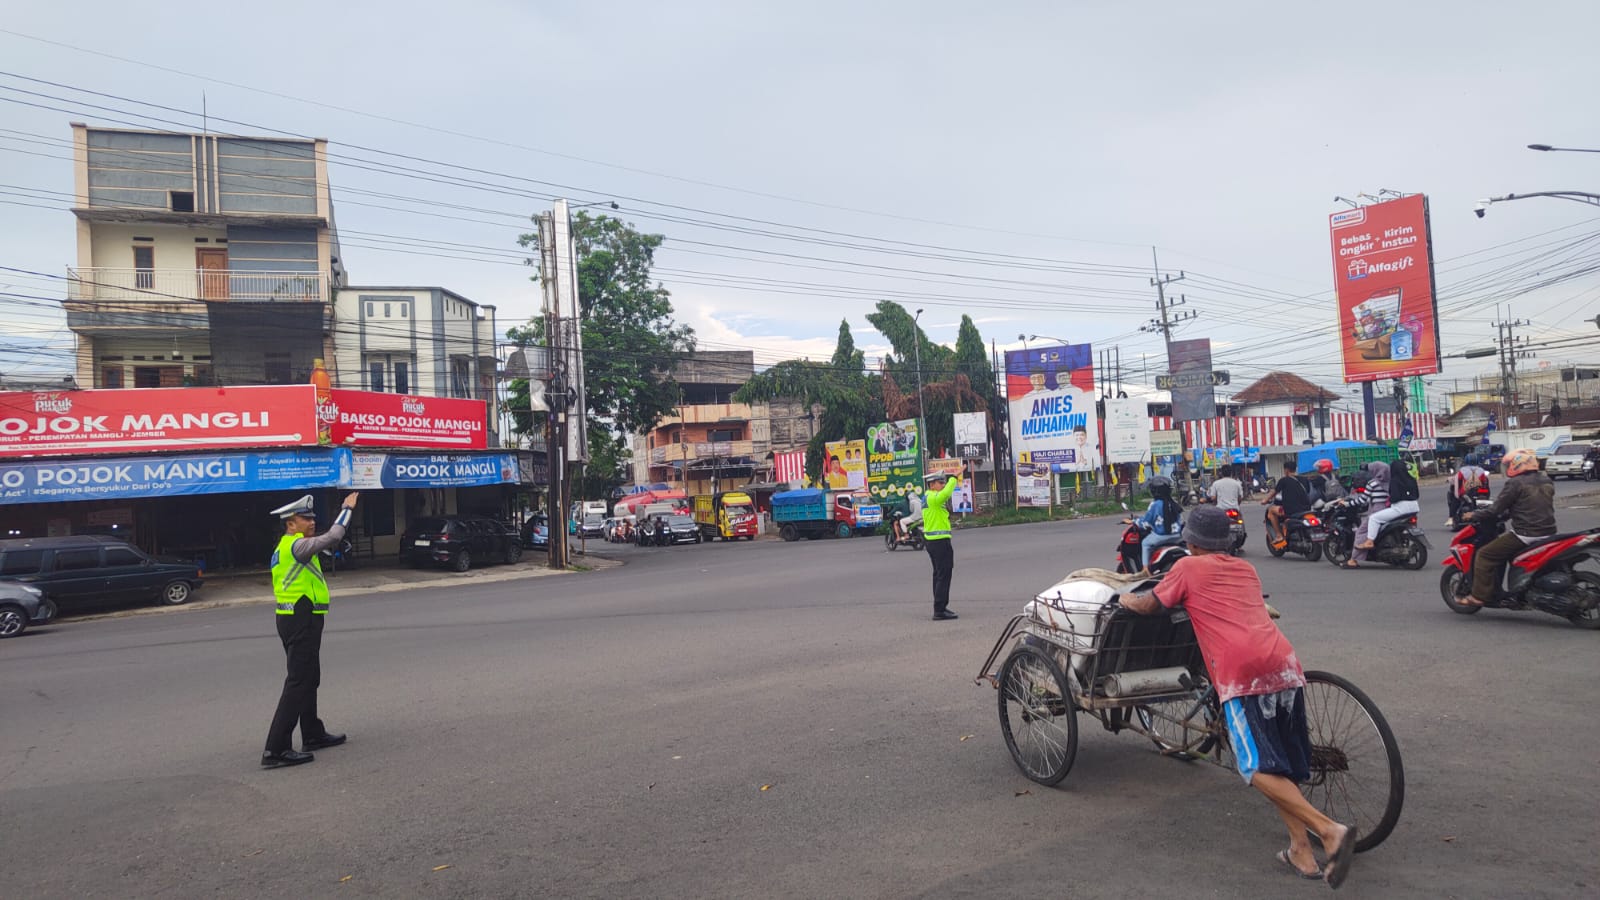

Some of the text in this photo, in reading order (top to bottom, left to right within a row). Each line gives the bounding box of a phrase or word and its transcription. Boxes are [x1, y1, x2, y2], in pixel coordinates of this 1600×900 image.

[1333, 211, 1361, 222] Alfamart
[1340, 232, 1371, 246] Bebas
[1384, 225, 1413, 239] Kirim
[1339, 235, 1417, 256] Ongkir Instan
[1368, 255, 1414, 274] Alfagift
[1040, 353, 1048, 363] 5
[1031, 395, 1073, 418] ANIES
[121, 411, 269, 431] MANGLI
[341, 412, 482, 431] BAKSO POJOK MANGLI
[1021, 412, 1088, 436] MUHAIMIN
[29, 433, 88, 441] PEREMPATAN
[869, 453, 894, 464] PPDB
[37, 464, 133, 486] POJOK
[143, 461, 246, 481] MANGLI
[396, 461, 497, 478] POJOK MANGLI
[132, 482, 150, 490] Dari
